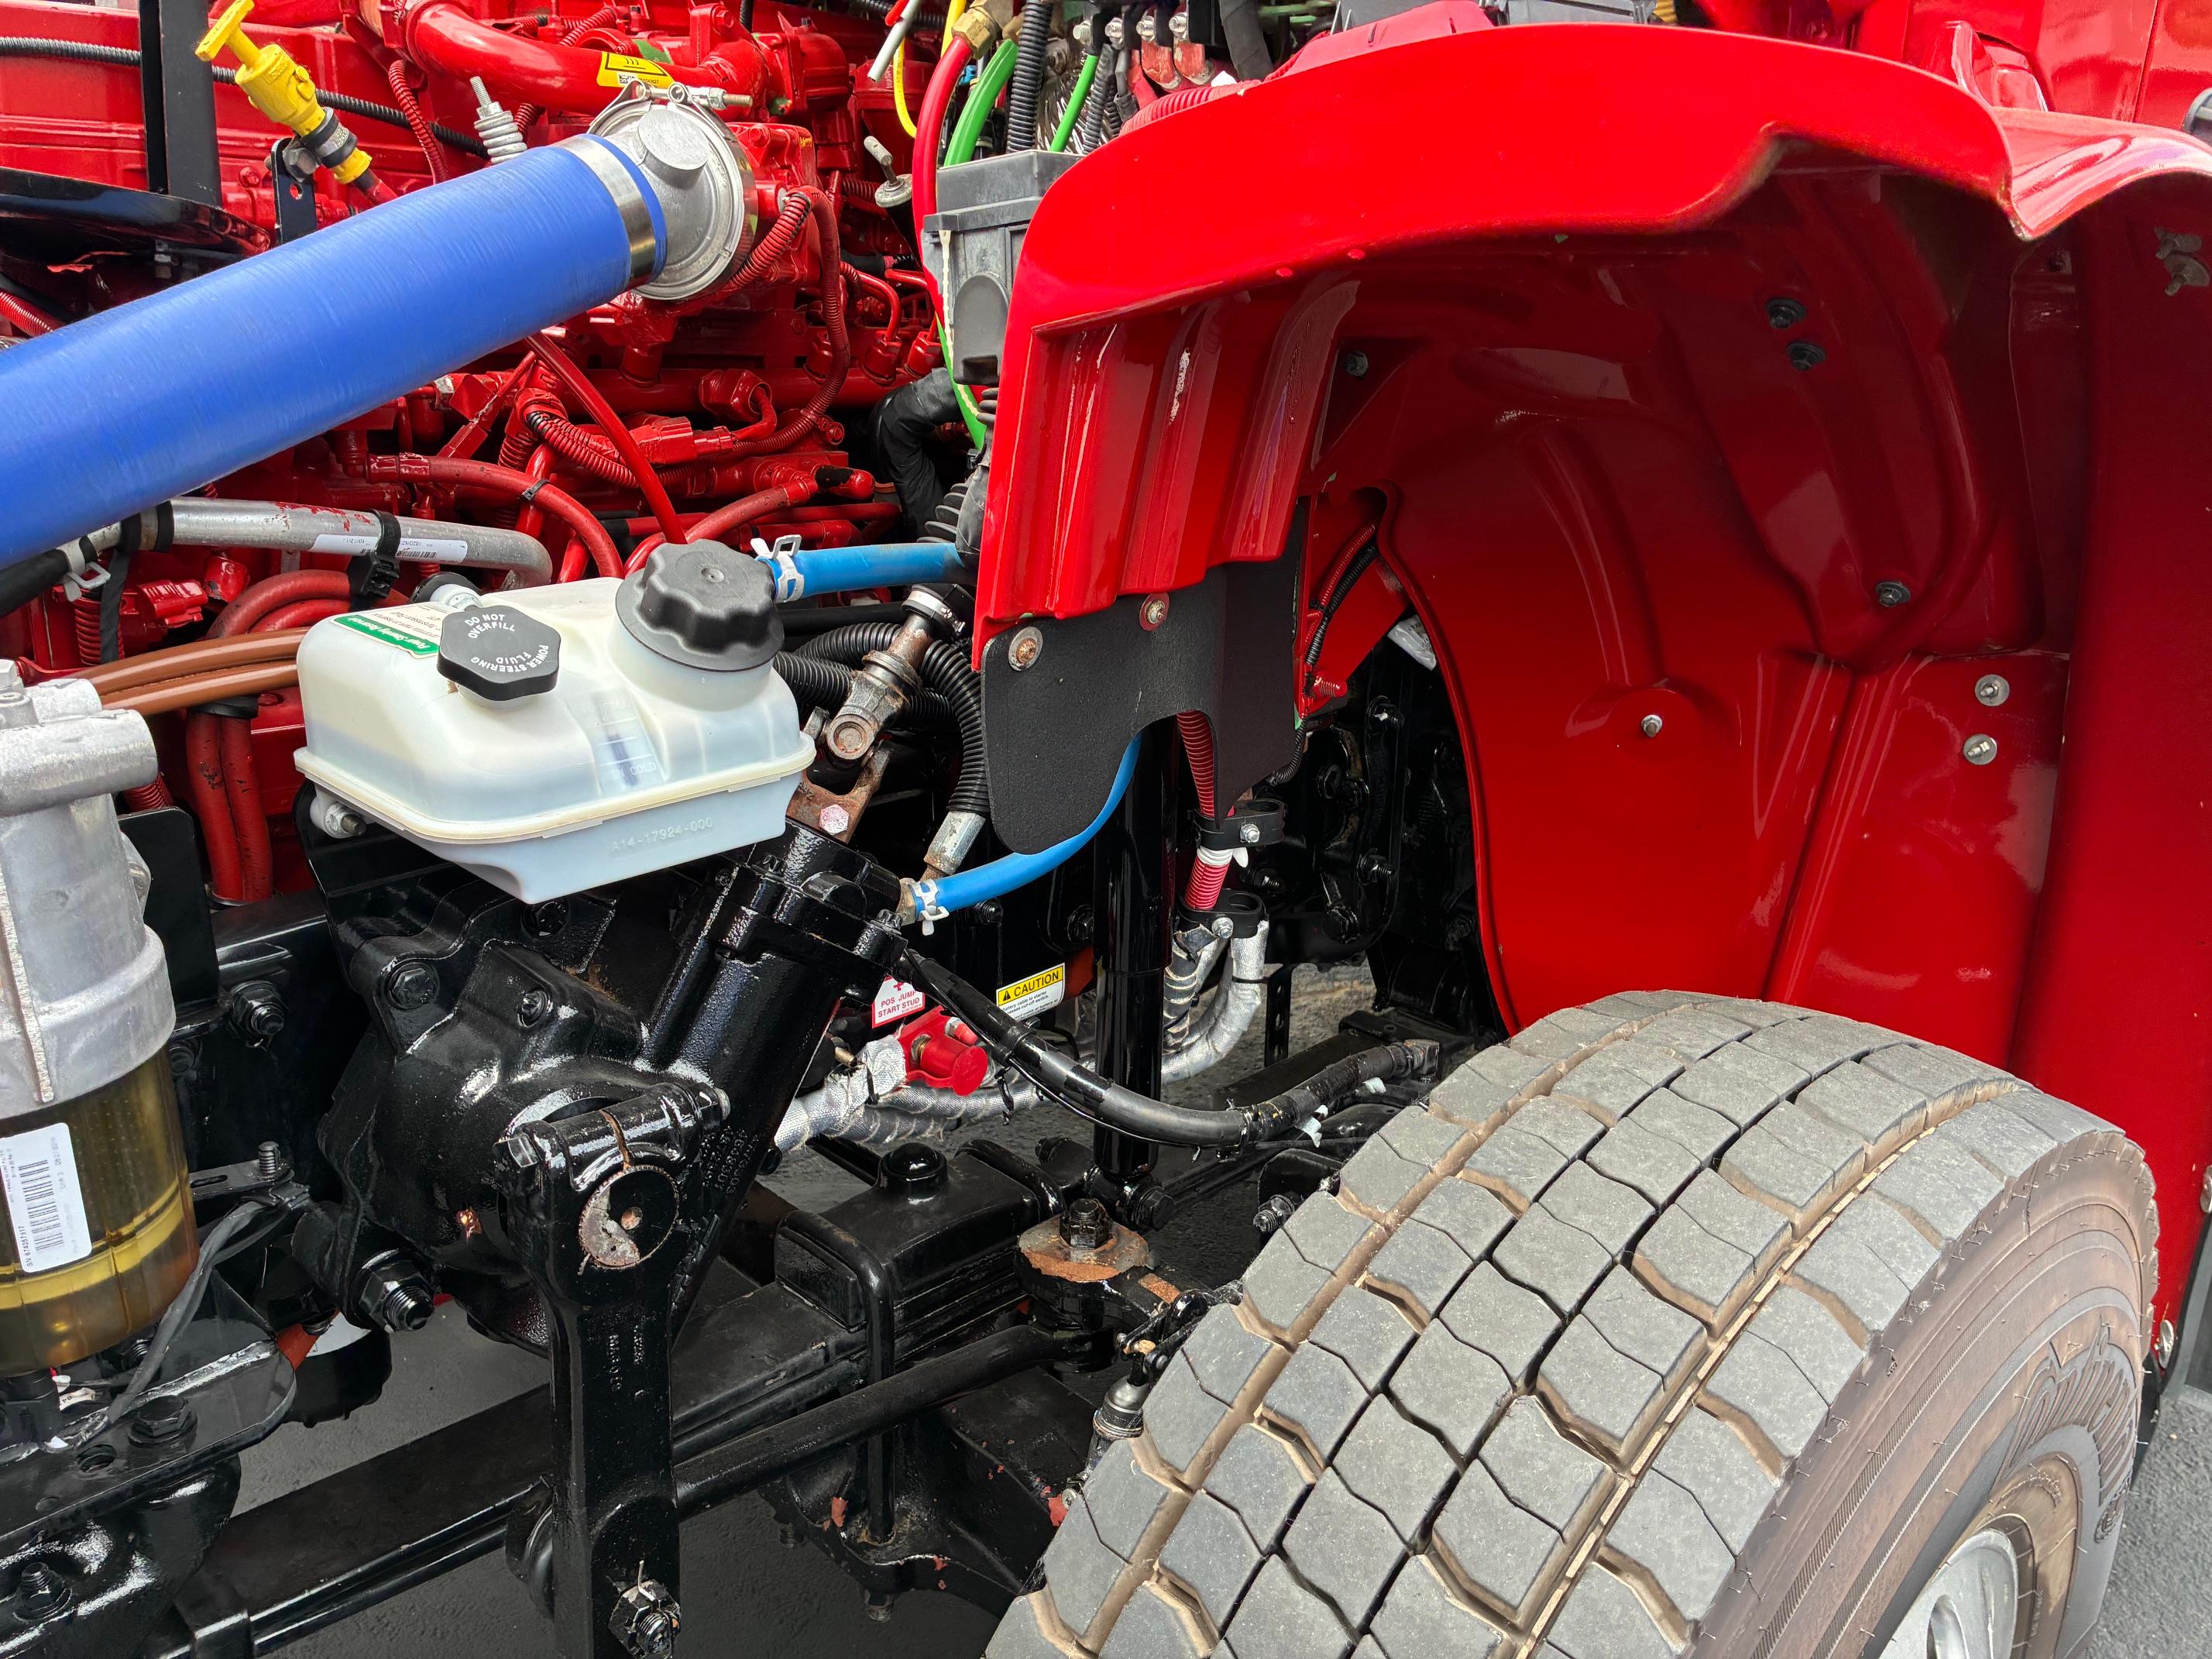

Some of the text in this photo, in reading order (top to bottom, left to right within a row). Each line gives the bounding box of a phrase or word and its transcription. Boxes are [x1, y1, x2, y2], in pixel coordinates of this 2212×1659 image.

[465, 617, 480, 627] DO
[468, 622, 516, 639] OVERFILL
[471, 644, 548, 673] POWER STEERING
[496, 652, 532, 665] FLUID
[630, 761, 657, 776] COLD
[1014, 970, 1059, 997] CAUTION
[878, 1005, 900, 1018] START
[902, 998, 920, 1009] STUD
[881, 997, 895, 1008] POS
